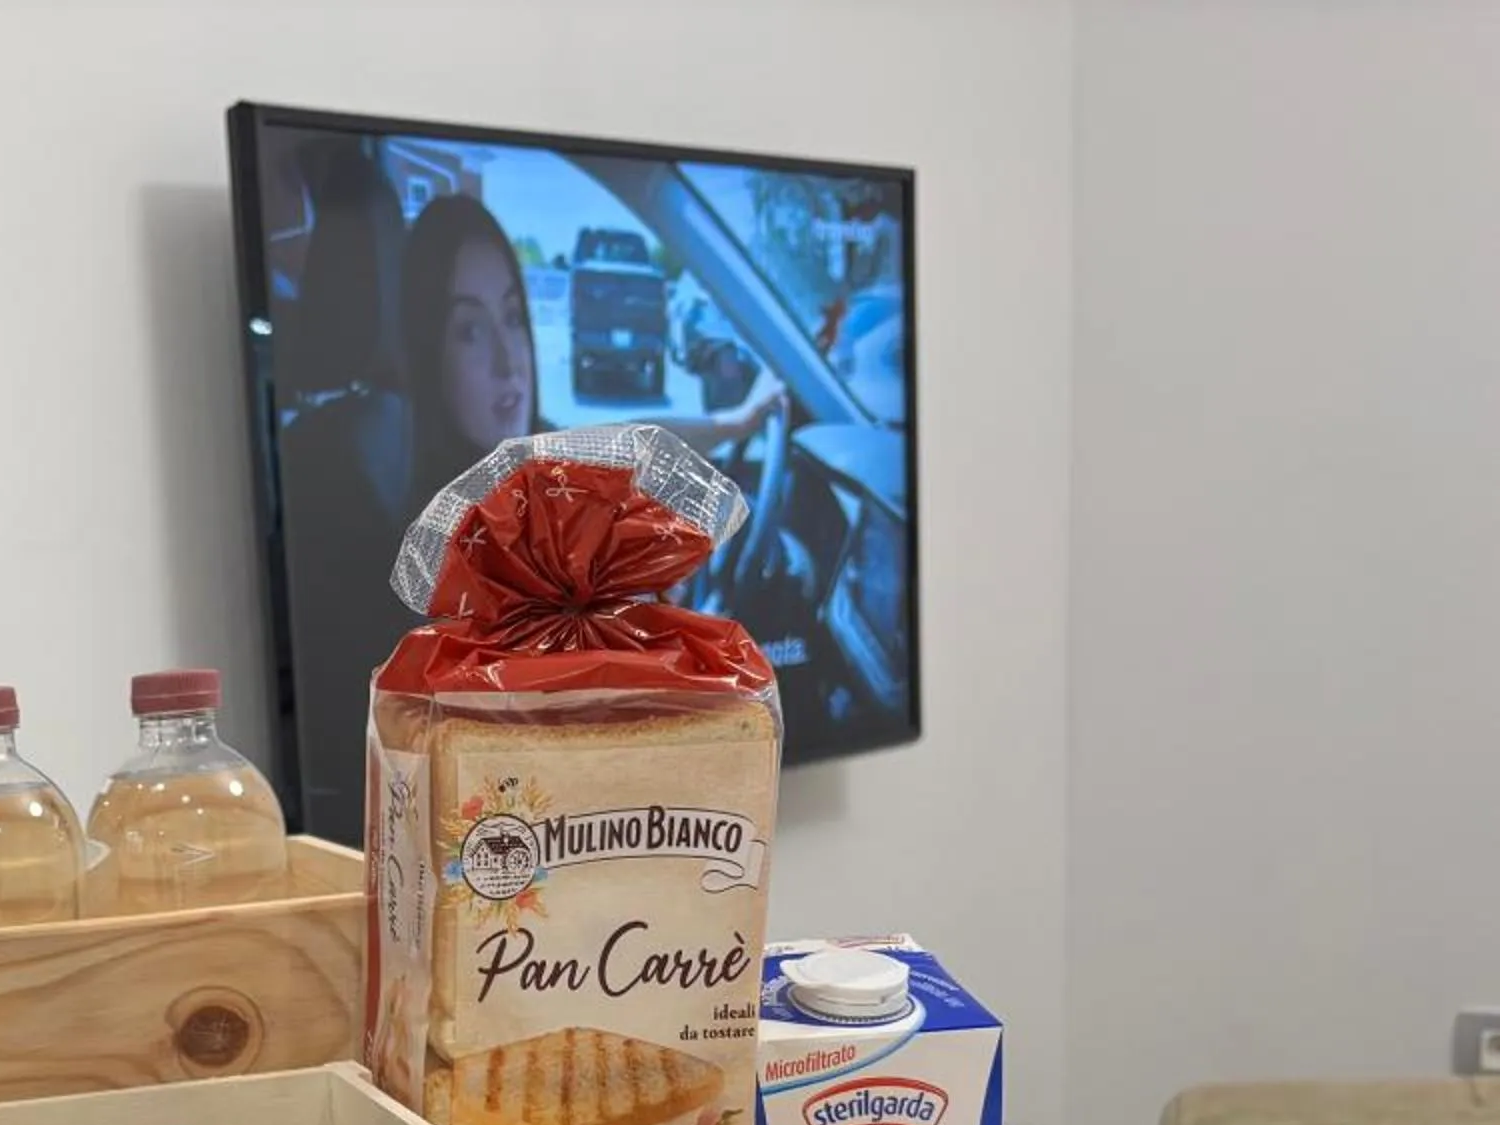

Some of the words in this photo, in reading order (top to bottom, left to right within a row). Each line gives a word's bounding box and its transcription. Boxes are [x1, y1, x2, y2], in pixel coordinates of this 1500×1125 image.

[545, 812, 638, 864] MULINO
[646, 805, 743, 853] BIANCO
[477, 926, 590, 1003] Pan
[598, 920, 751, 999] Carrè
[713, 1003, 756, 1022] ideali
[679, 1025, 698, 1042] da
[702, 1023, 756, 1041] tostare
[765, 1045, 856, 1083] Microfiltrato
